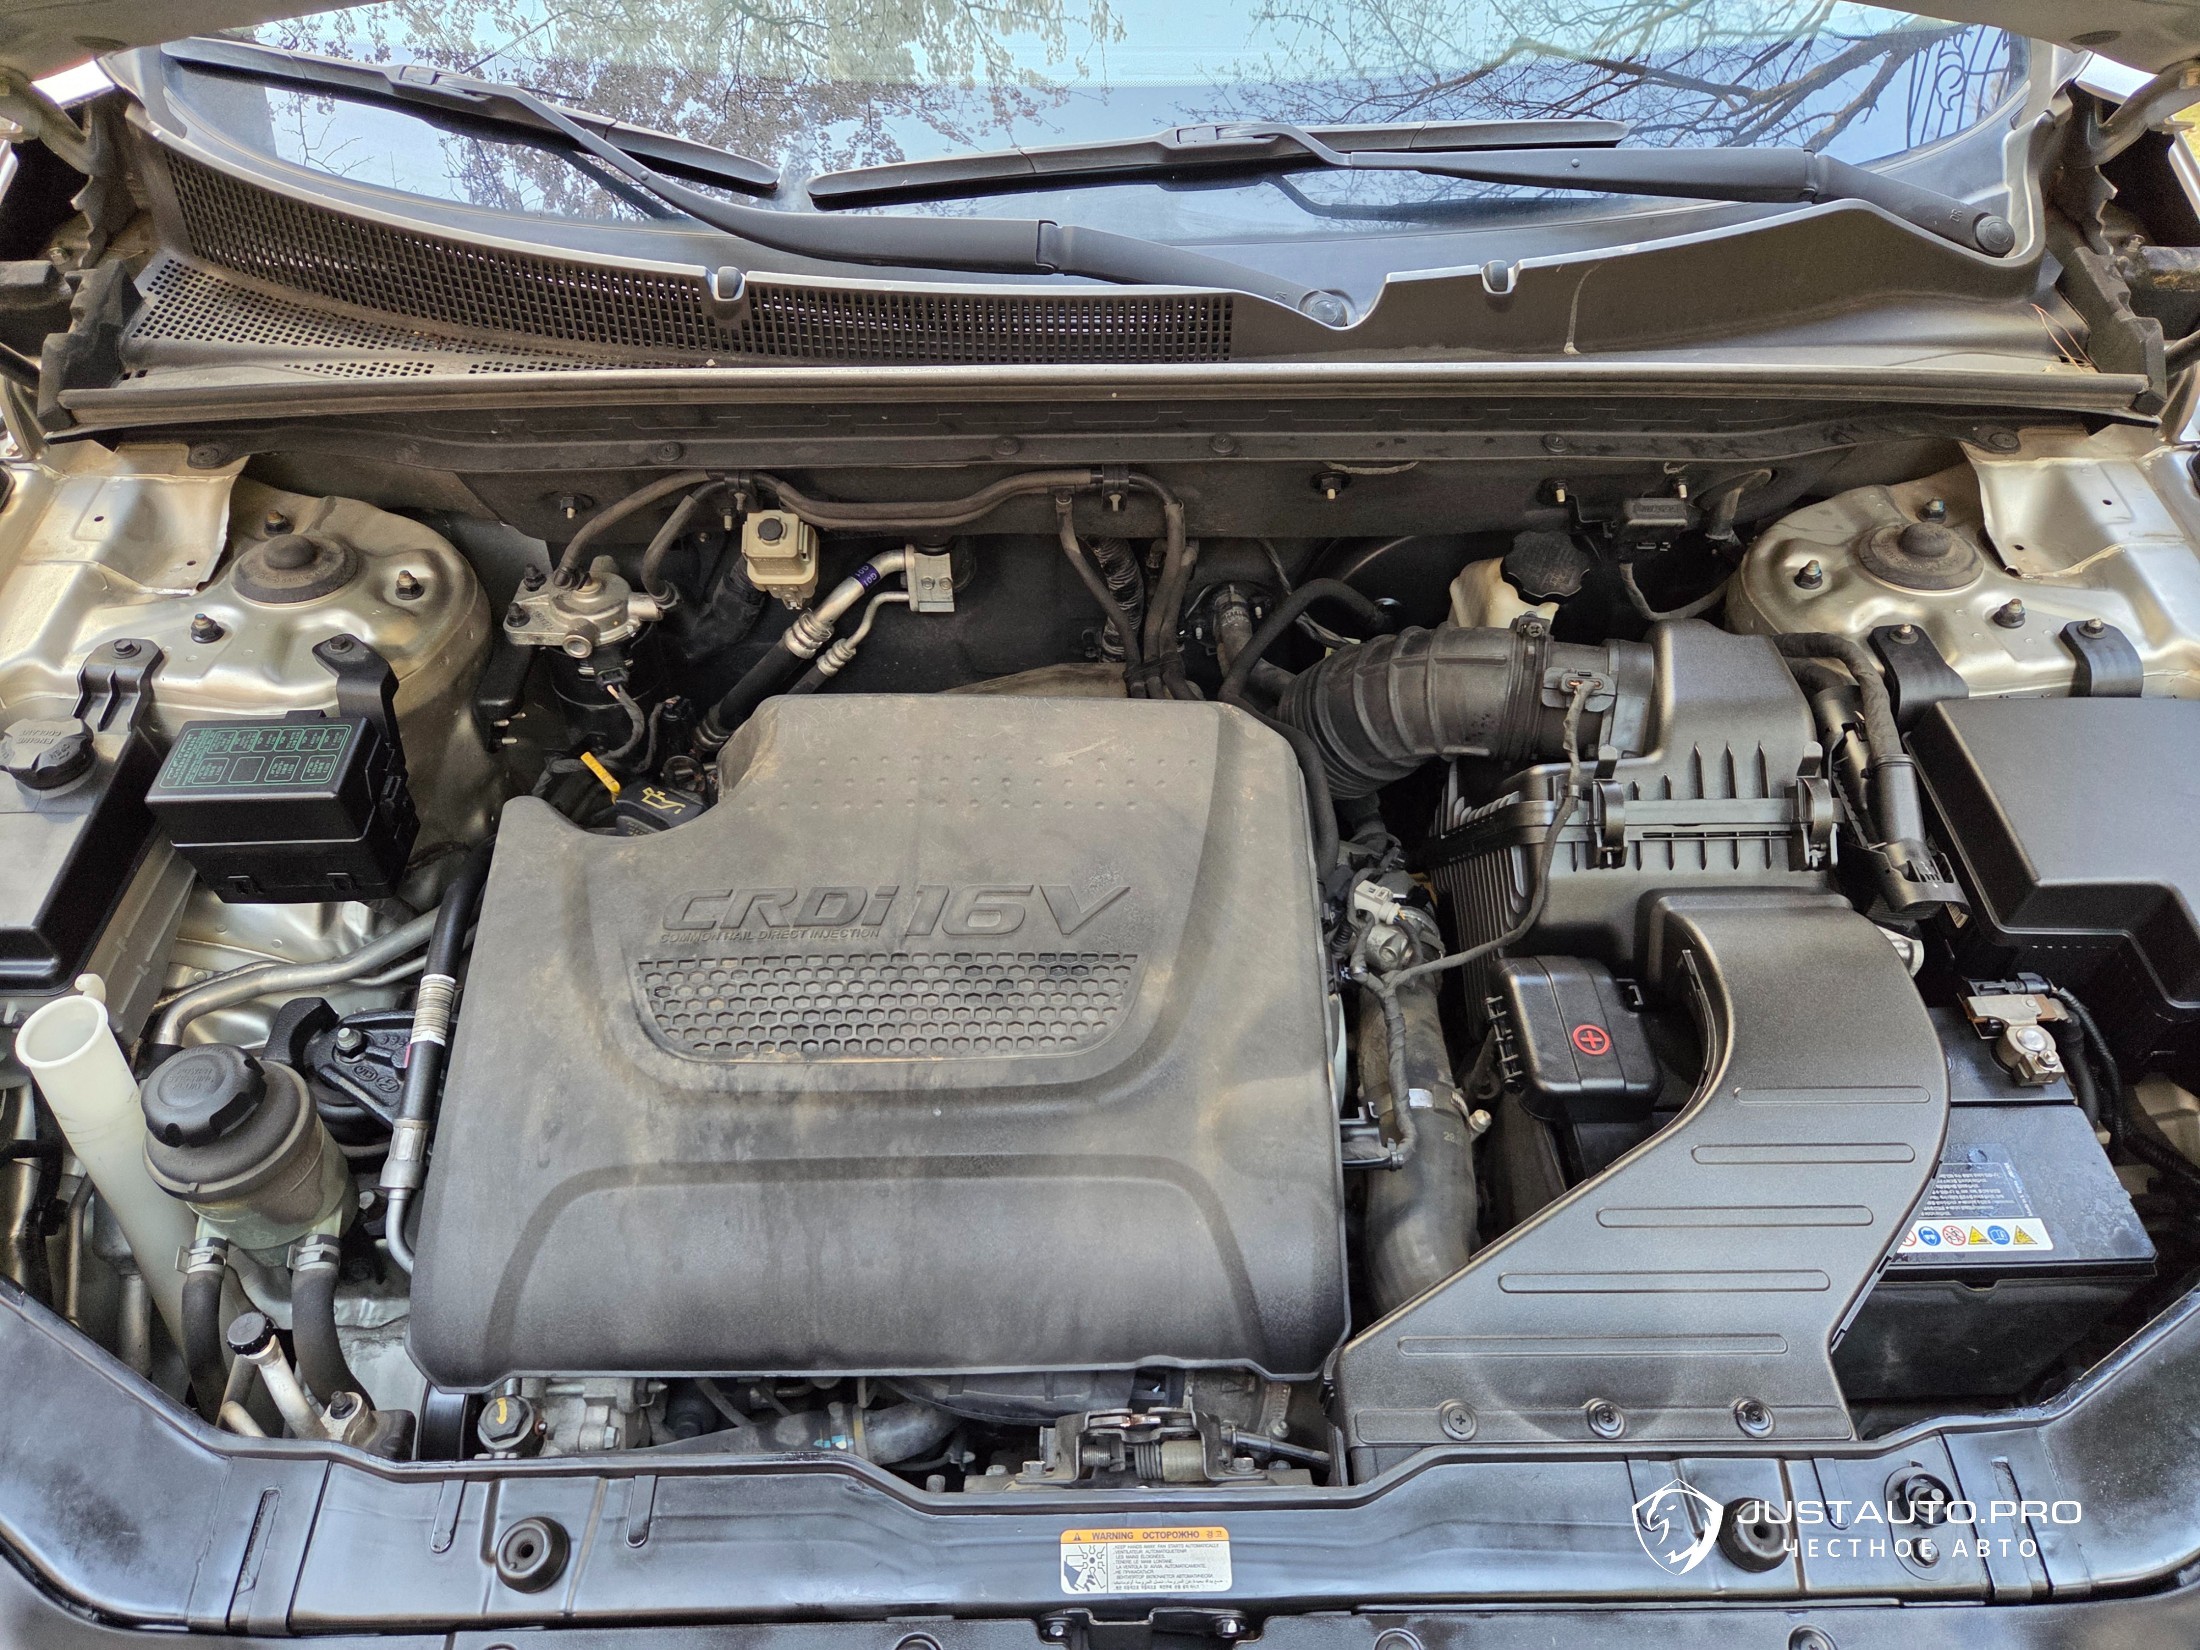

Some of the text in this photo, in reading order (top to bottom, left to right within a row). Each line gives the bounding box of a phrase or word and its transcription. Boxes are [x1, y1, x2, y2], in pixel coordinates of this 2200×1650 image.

[863, 572, 877, 586] G01
[660, 928, 879, 943] COMMON RAIL DIRECT INJECTION
[1092, 1532, 1134, 1541] WARNING
[1142, 1531, 1200, 1539] ОСТОРОЖНО
